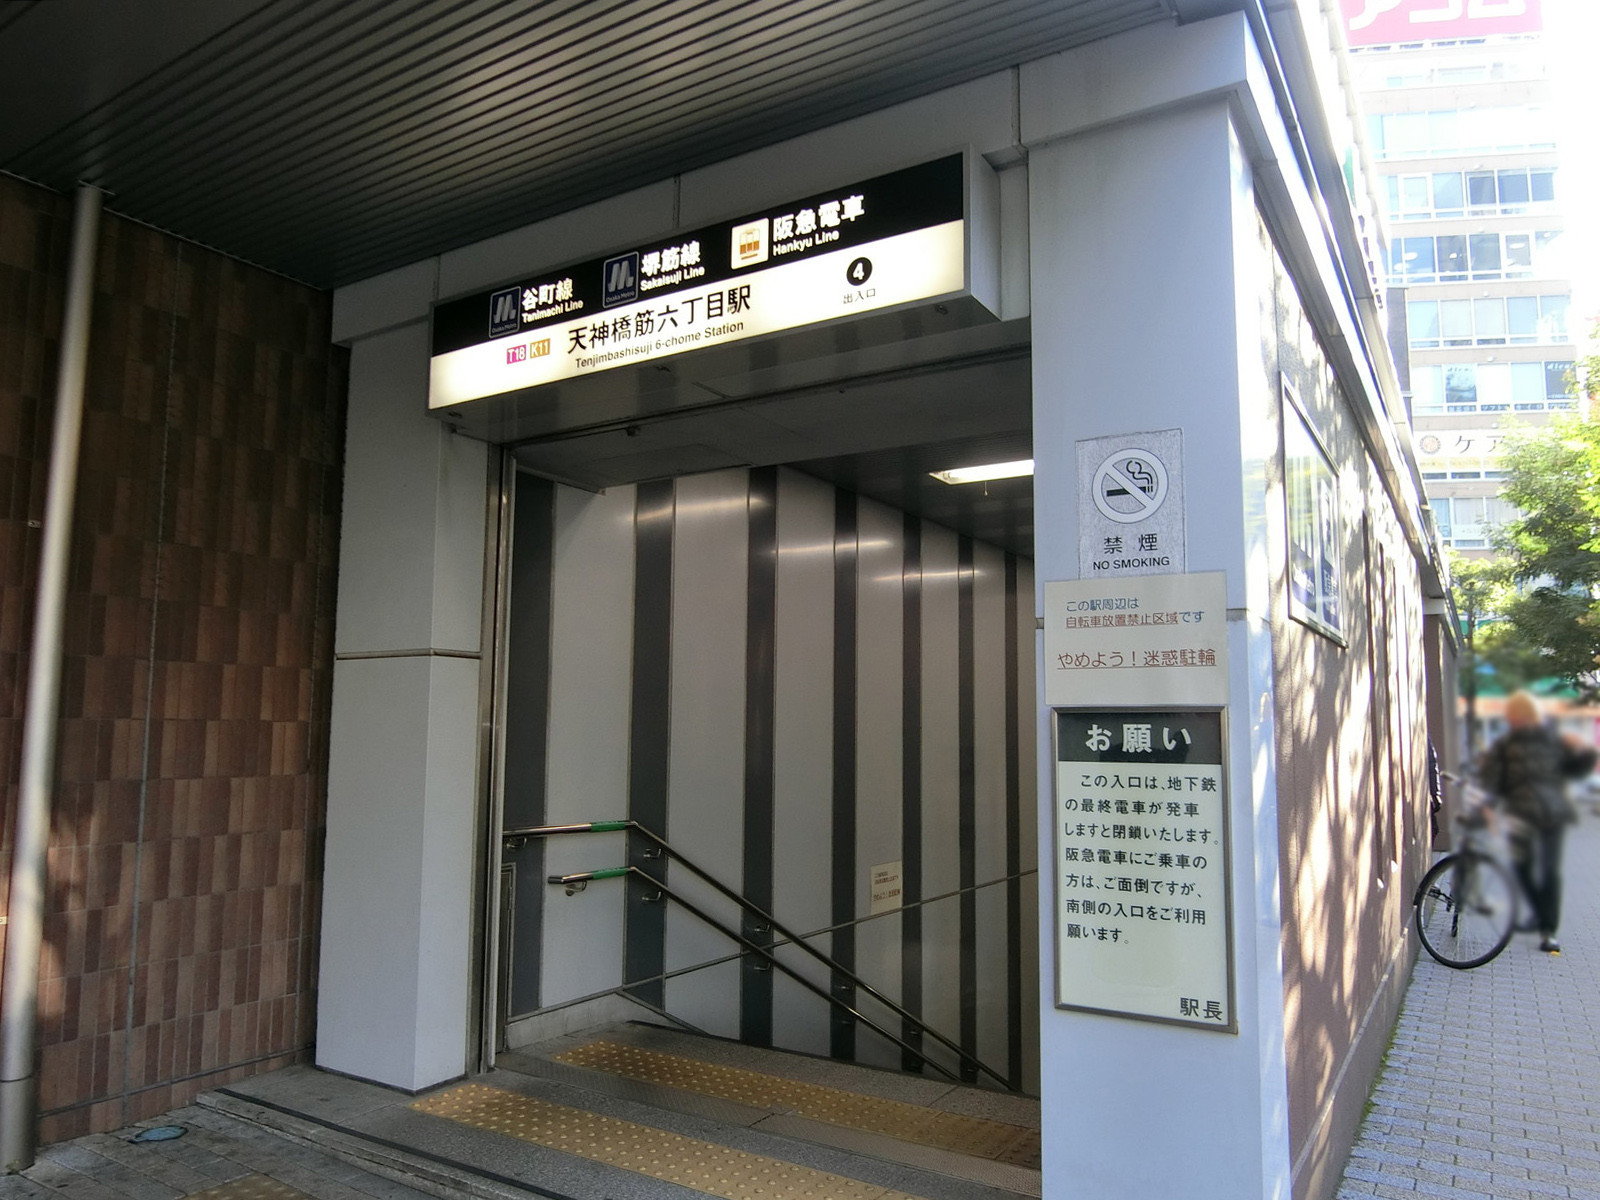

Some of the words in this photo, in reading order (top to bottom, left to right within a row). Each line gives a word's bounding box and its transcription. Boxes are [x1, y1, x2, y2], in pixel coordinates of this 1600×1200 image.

[773, 195, 865, 242] 阪急電車
[773, 237, 813, 256] Hankyu
[815, 230, 840, 245] Line
[641, 240, 701, 277] 堺筋線
[640, 270, 682, 291] Sakaisuji
[683, 266, 705, 280] Line
[522, 278, 573, 311] 谷町線
[843, 288, 876, 304] 出入口
[521, 303, 564, 323] Tanimachi
[564, 299, 584, 312] Line
[567, 285, 751, 354] 天神橋筋六丁目駅
[507, 346, 526, 363] T18
[530, 339, 550, 357] K11
[576, 342, 653, 369] Tenjimbashisuji
[655, 331, 701, 350] 6-chome
[704, 321, 744, 338] Station
[1103, 533, 1158, 554] 禁煙
[1093, 560, 1111, 570] NO
[1113, 556, 1170, 569] SMOKING
[1066, 597, 1139, 612] この駅周辺は
[1065, 610, 1205, 628] 自転車放置禁止区域です
[1085, 723, 1192, 753] お願い
[1081, 774, 1217, 792] この入口は、地下鉄
[1065, 798, 1200, 818] の最終電車が発車
[1064, 822, 1219, 845] しますと閉鎖いたします。
[1065, 847, 1208, 869] 阪急電車にご乗車の
[1066, 873, 1202, 898] 方は、ご面倒ですが、
[1066, 899, 1206, 925] 南側の入口をご利用
[1067, 924, 1129, 944] 願います。
[1180, 997, 1223, 1021] 駅長
